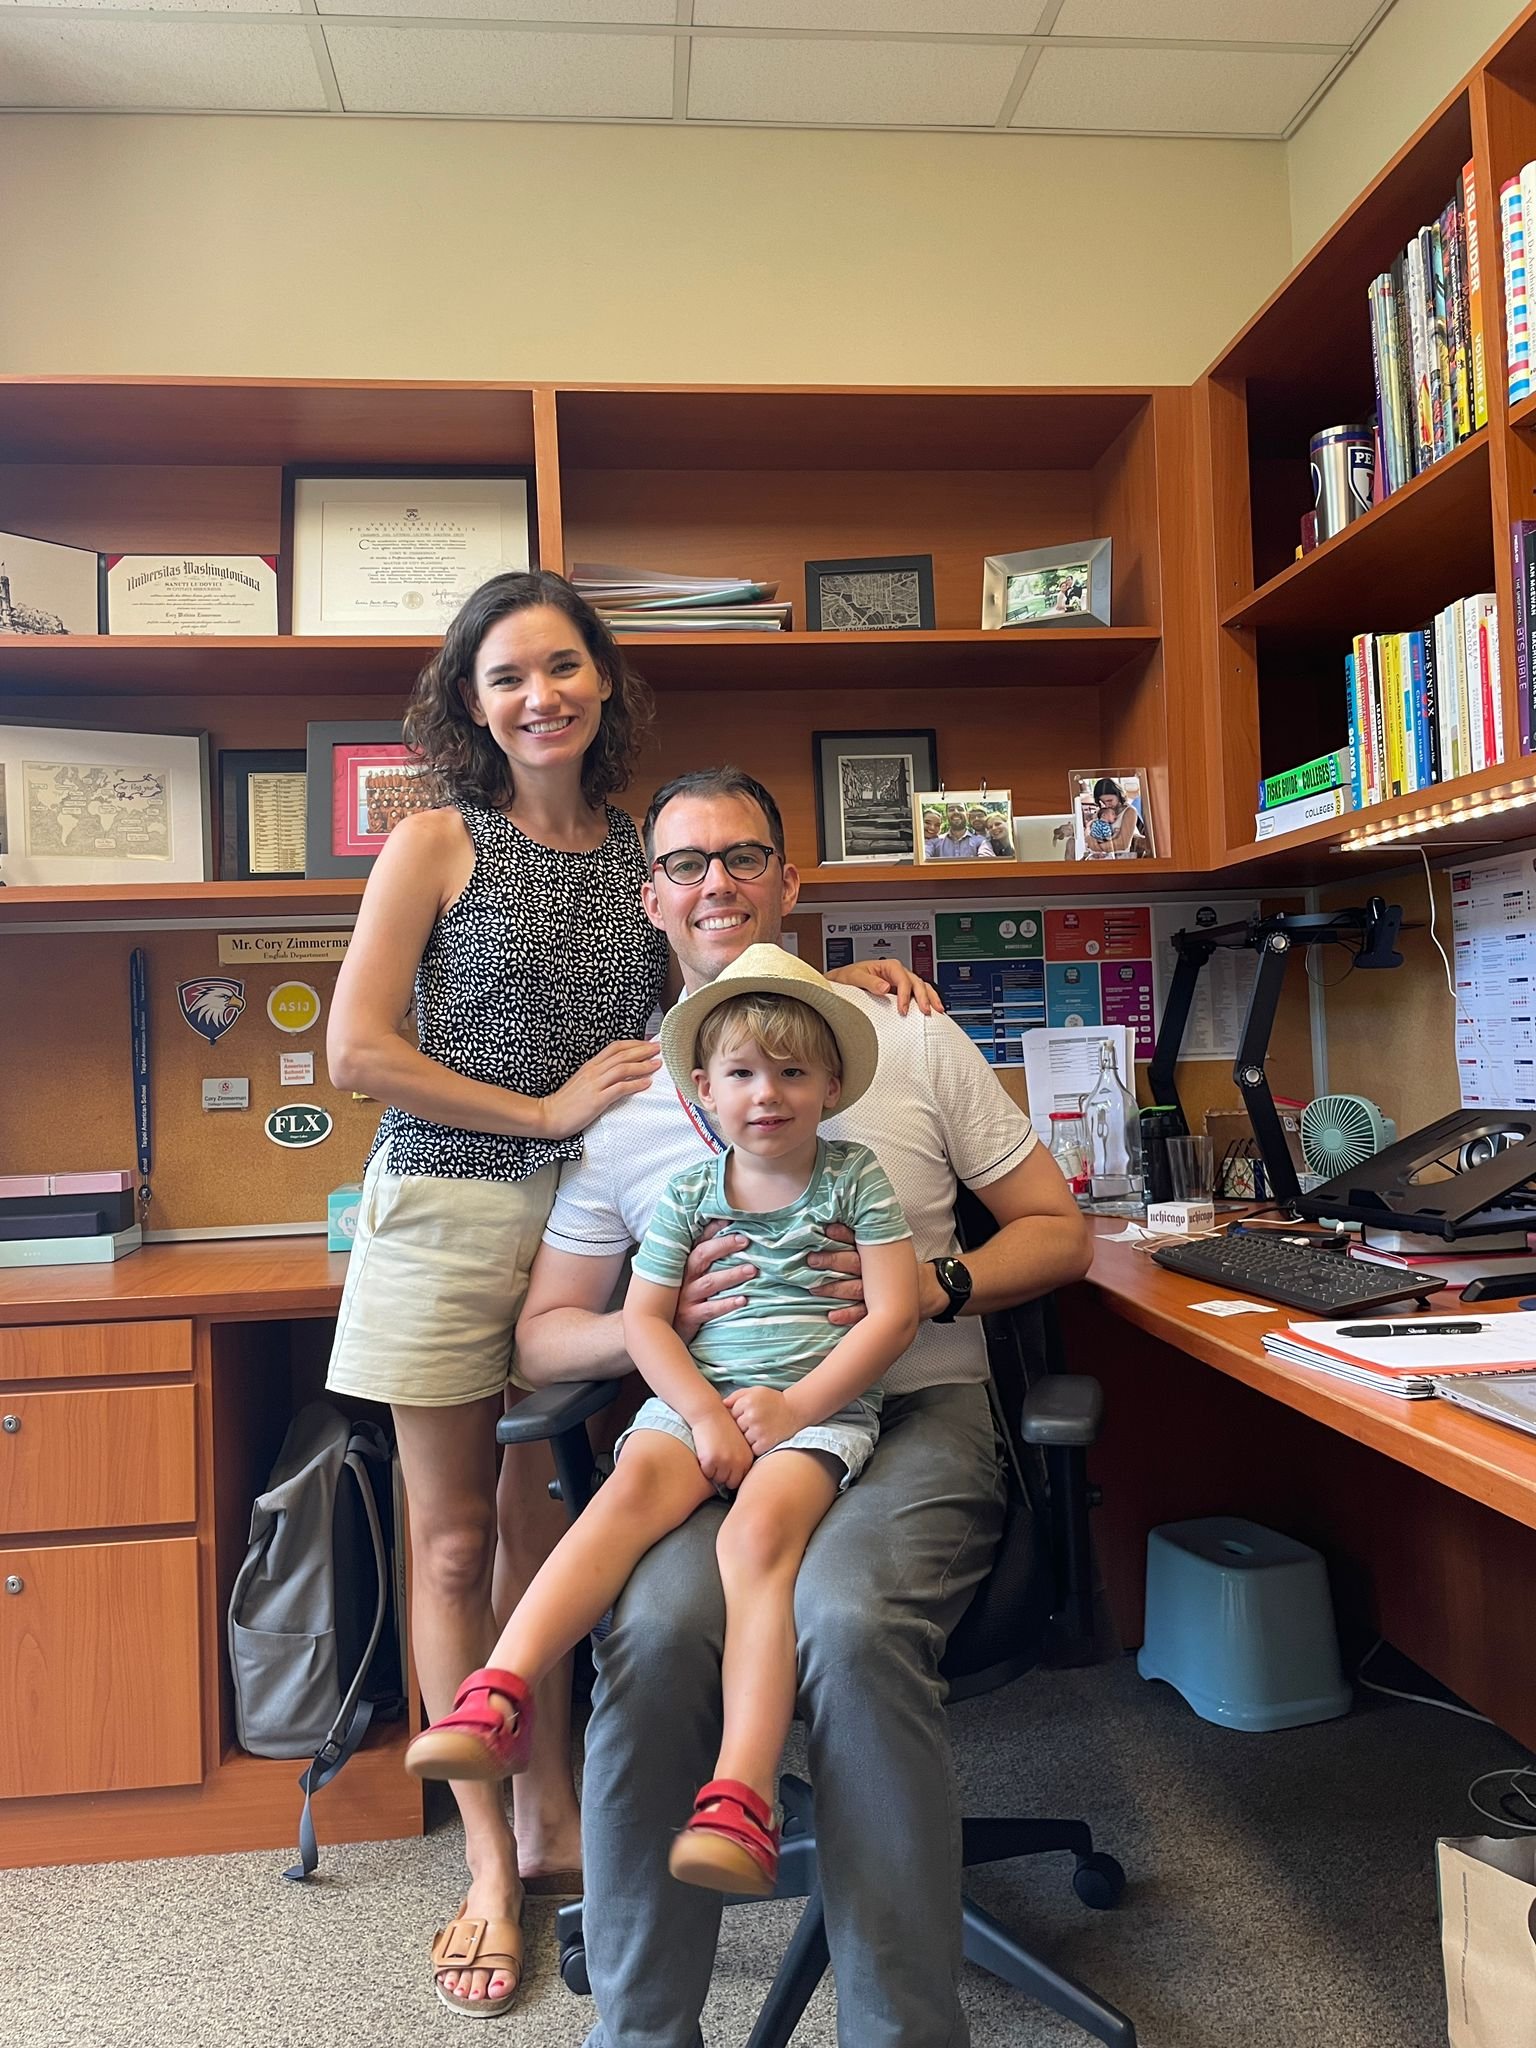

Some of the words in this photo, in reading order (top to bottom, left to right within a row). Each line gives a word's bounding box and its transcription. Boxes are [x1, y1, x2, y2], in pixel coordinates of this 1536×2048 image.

[1466, 183, 1480, 295] ISLANDER
[1475, 333, 1483, 394] VOLUME
[127, 564, 181, 591] Universitas
[1423, 629, 1432, 648] SIN
[1516, 627, 1525, 652] BTS
[1517, 655, 1527, 690] BIBLE
[1425, 661, 1435, 717] SYNTAX
[1348, 727, 1355, 746] 90
[1349, 746, 1357, 780] DAYS
[1266, 780, 1282, 803] FISKE
[1281, 773, 1298, 797] GUIDE
[1301, 763, 1331, 790] COLLEGES
[1304, 803, 1335, 819] COLLEGES
[849, 923, 862, 931] HIGH
[863, 922, 883, 931] SCHOOL
[884, 922, 905, 930] PROFILE
[232, 939, 252, 950] Mr.
[255, 938, 284, 952] Cory
[286, 937, 351, 949] Zimmerma
[263, 952, 288, 960] English
[290, 951, 329, 959] Department
[279, 1002, 310, 1011] ASIJ
[140, 1085, 148, 1104] School
[274, 1114, 321, 1133] FLX
[141, 1131, 149, 1149] Taipei
[1150, 1210, 1186, 1227] uchicago
[1188, 1210, 1213, 1224] uchicago
